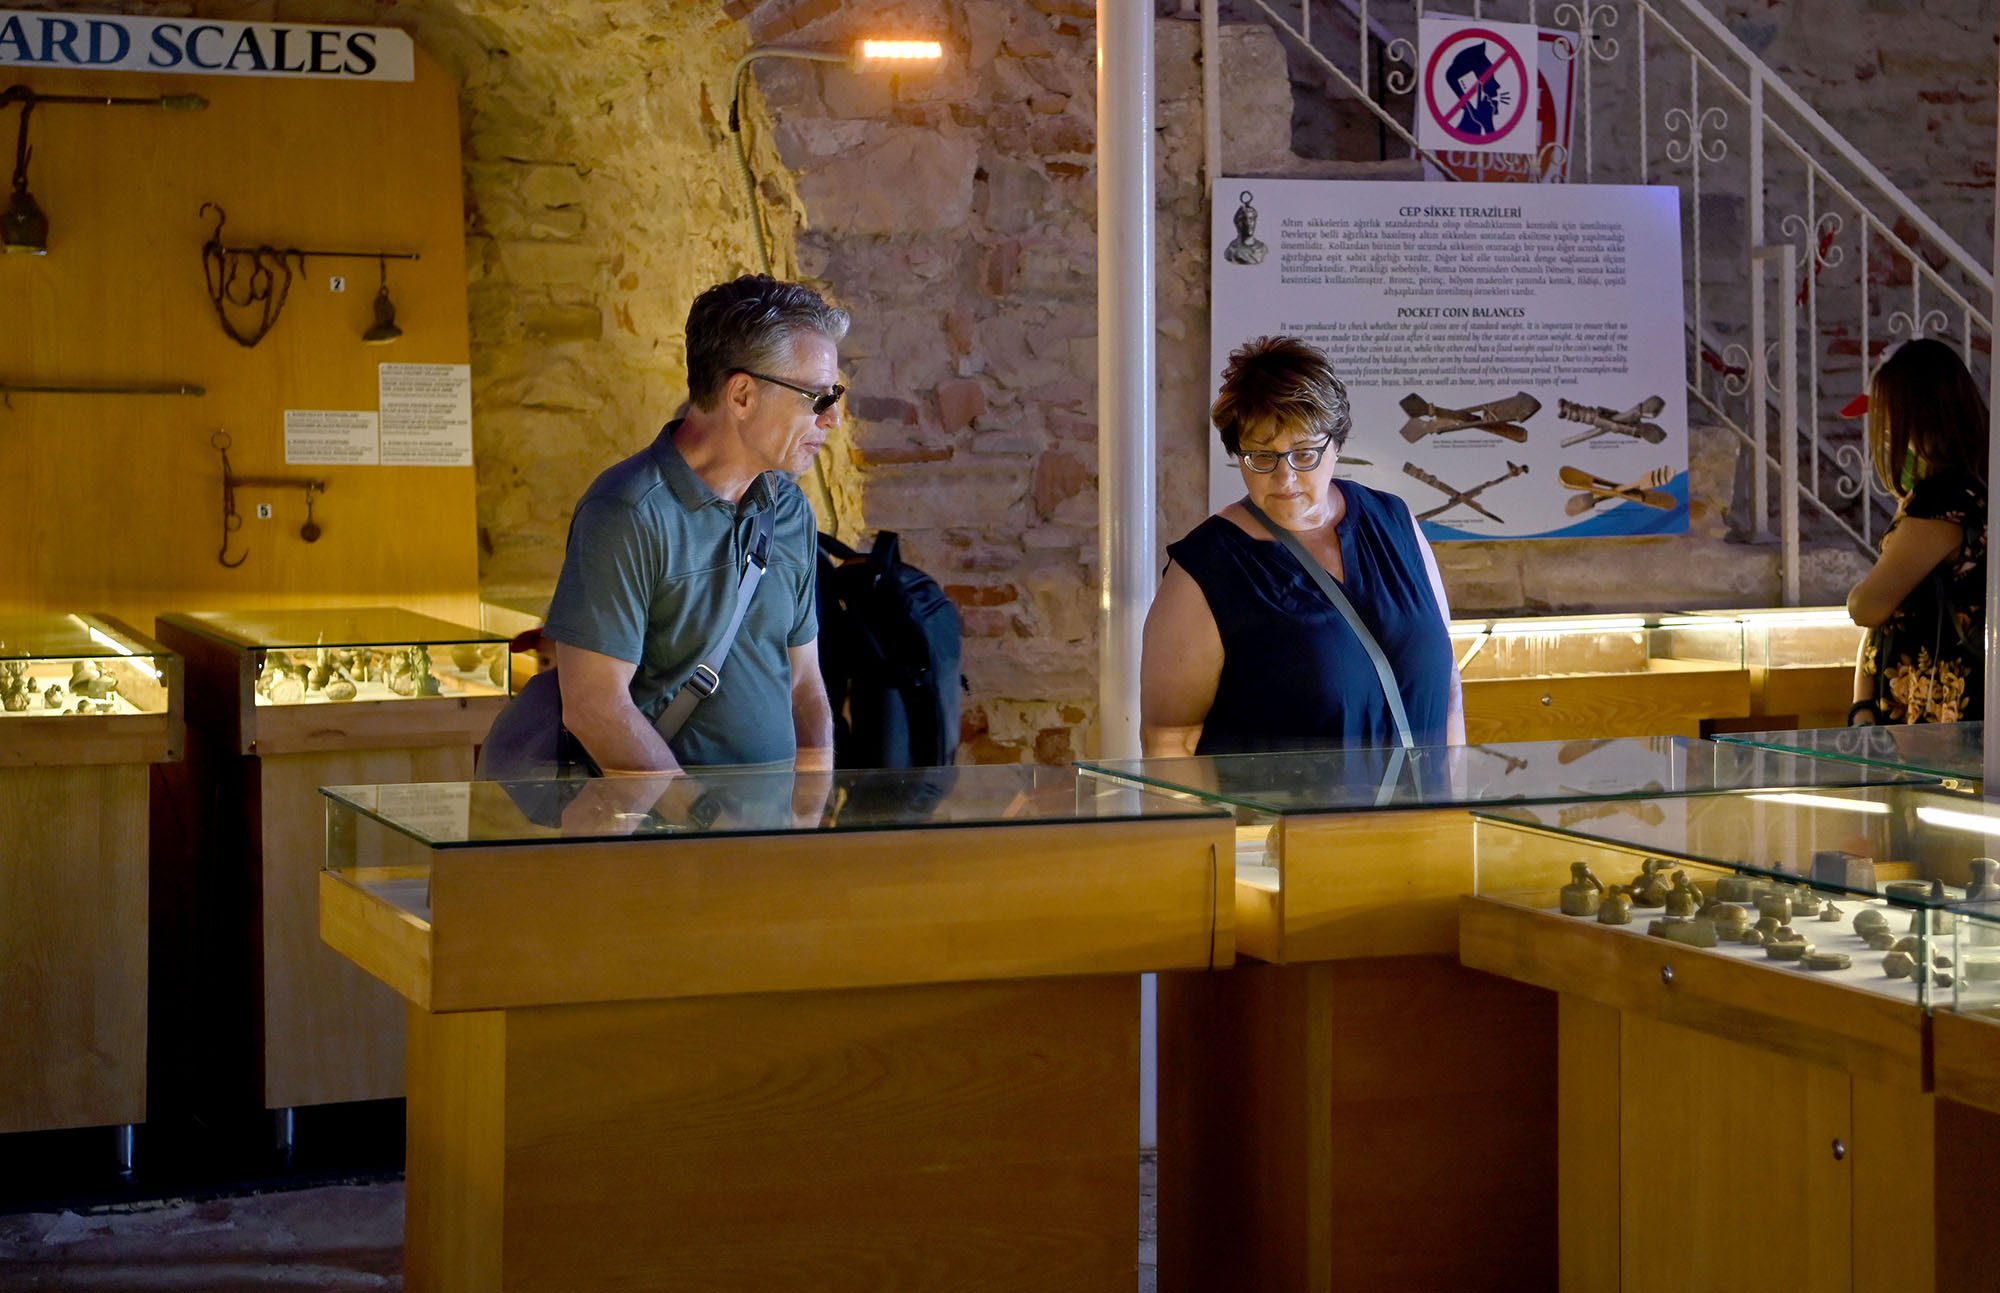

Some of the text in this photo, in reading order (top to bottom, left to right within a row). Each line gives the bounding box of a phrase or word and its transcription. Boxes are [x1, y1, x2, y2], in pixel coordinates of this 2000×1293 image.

[0, 15, 377, 74] ARD SCALES
[1399, 205, 1522, 218] CEP SİKKE TERAZİLERİ
[1397, 307, 1526, 318] POCKET COIN BALANCES
